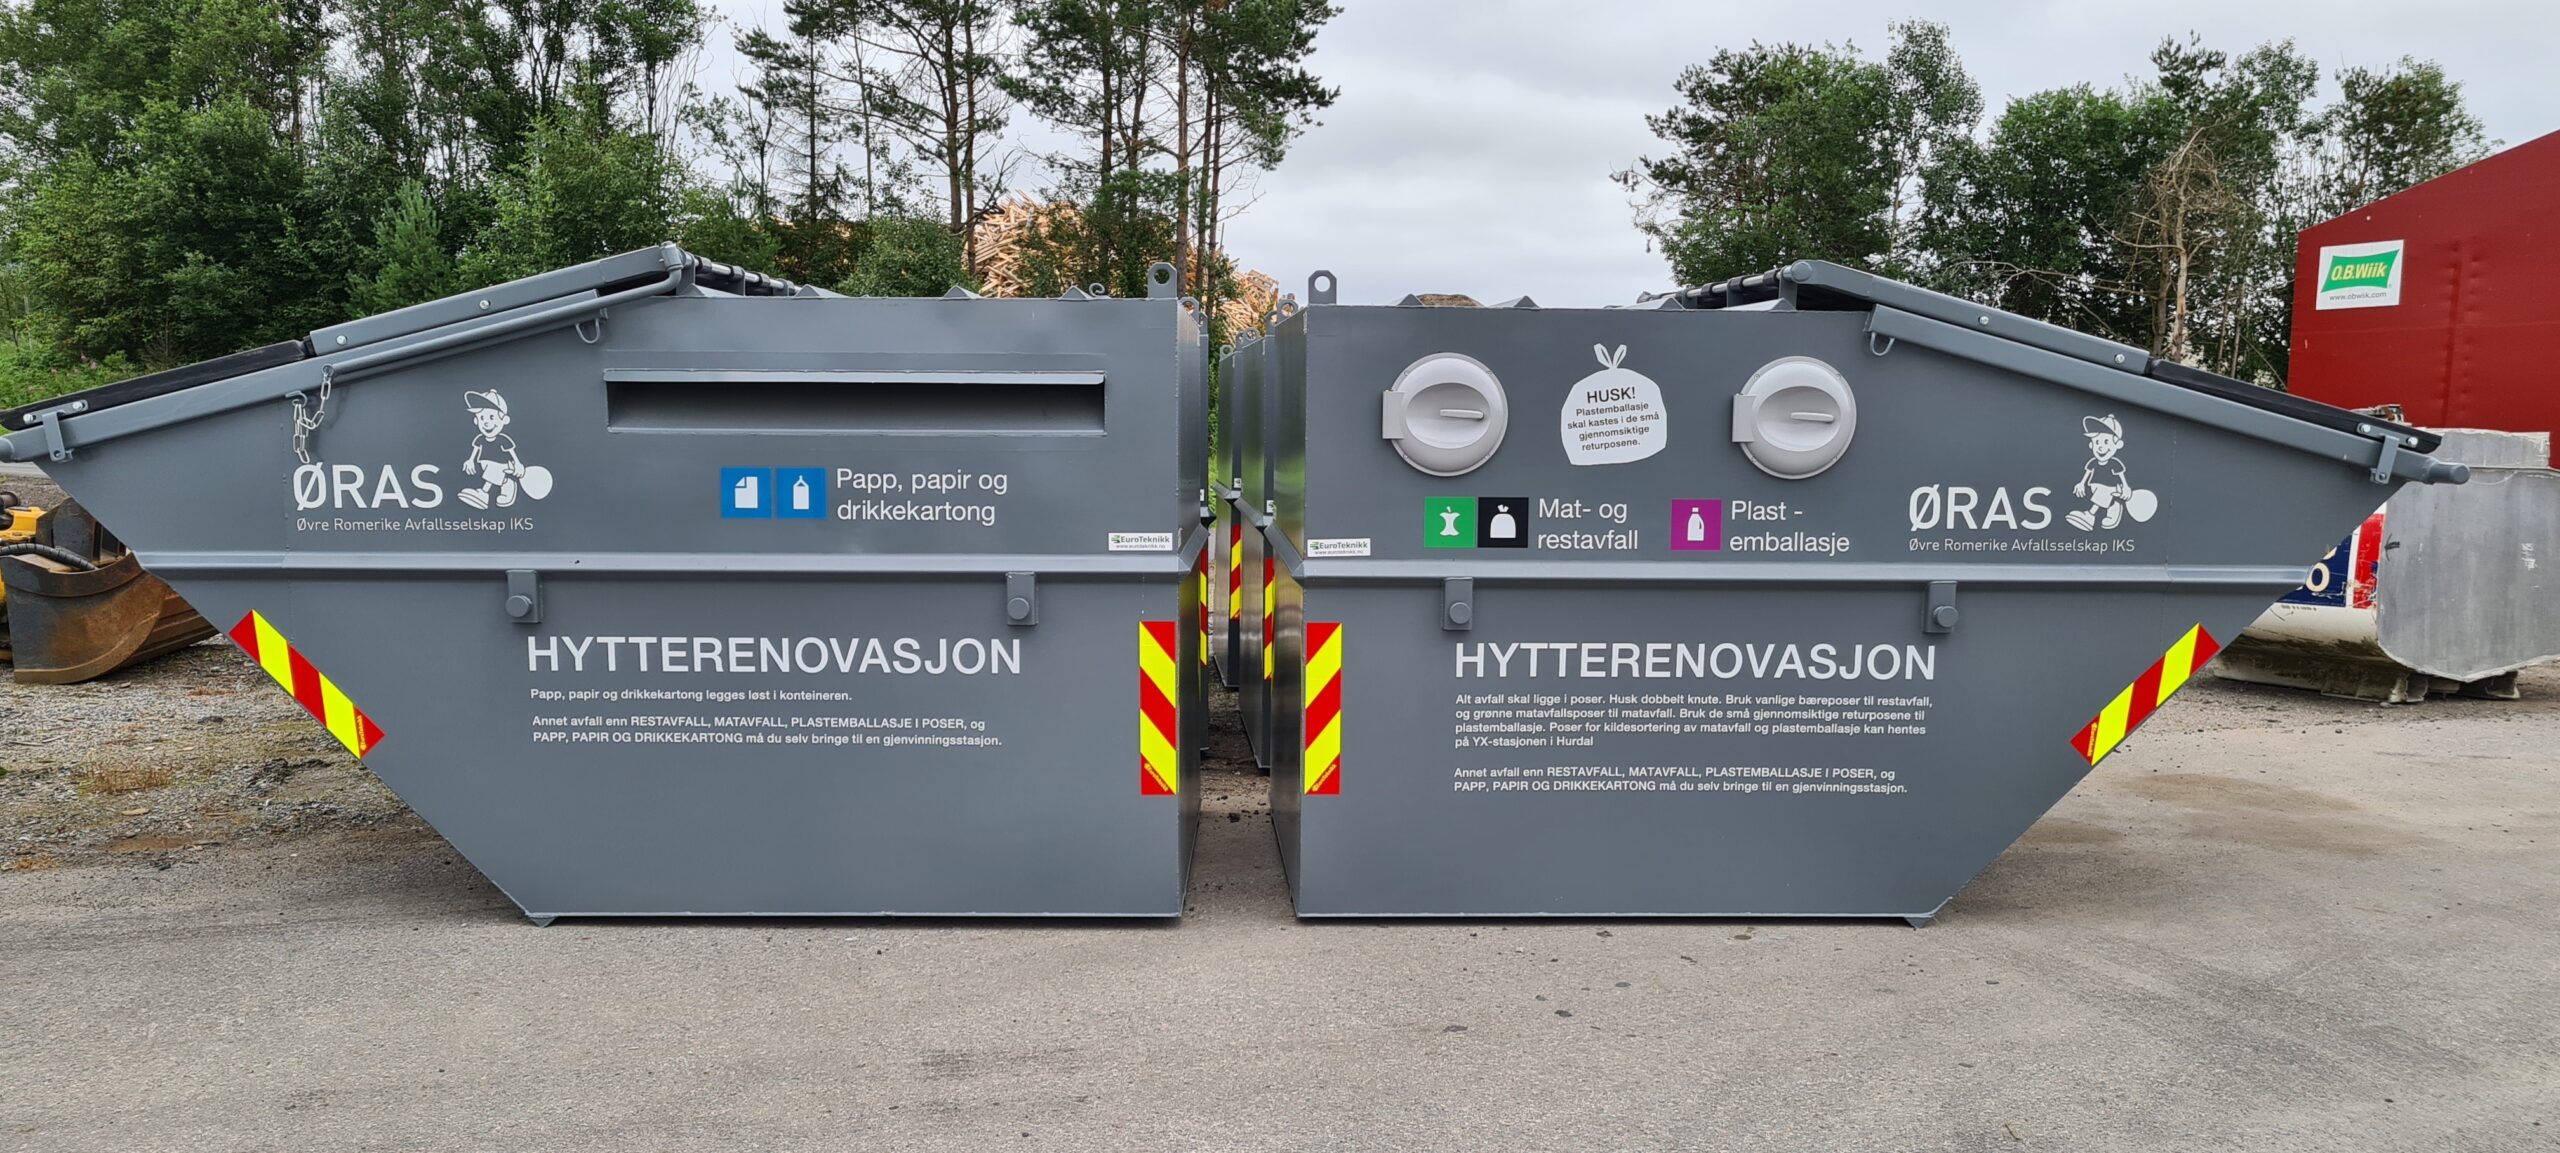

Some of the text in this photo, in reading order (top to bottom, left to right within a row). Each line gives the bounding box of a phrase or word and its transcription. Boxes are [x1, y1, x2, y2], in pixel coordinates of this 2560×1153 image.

[2331, 262, 2388, 281] O.B.Wiik
[1586, 386, 1636, 404] HUSK!
[1576, 402, 1649, 417] Plastemballasje
[1567, 419, 1586, 430] skal
[1588, 417, 1619, 428] kastes
[1625, 414, 1638, 424] de
[1639, 411, 1660, 422] små
[1578, 425, 1650, 442] gjennomsiktige
[1581, 439, 1641, 451] returposene.
[293, 461, 443, 511] ØRAS
[837, 468, 1008, 496] Papp, papir og
[837, 499, 995, 527] drikkekartong
[1539, 498, 1627, 524] Mat- og
[1731, 500, 1787, 521] Plast
[1909, 483, 2052, 532] ØRAS
[296, 517, 534, 534] Øvre Romerike Avfallsselskap IKS
[1120, 535, 1170, 543] EuroTeknikk
[1319, 541, 1368, 549] EuroTeknikk
[1538, 529, 1638, 550] restavfall
[1729, 531, 1850, 557] emballasje
[1909, 537, 2135, 555] Øvre Romerike Avfallsselskap IKS
[527, 636, 1021, 675] HYTTERENOVASJON
[1455, 642, 1936, 681] HYTTERENOVASJON
[530, 688, 566, 702] Papp,
[568, 688, 600, 702] papir
[602, 691, 618, 702] og
[620, 688, 703, 702] drikkekartong
[706, 689, 746, 702] legges
[748, 689, 771, 701] løst
[779, 690, 853, 701] konteineren.
[1455, 694, 1472, 705] Alt
[1474, 693, 1505, 705] avfall
[1507, 693, 1531, 704] skal
[1533, 693, 1561, 707] ligge
[1570, 695, 1606, 706] poser.
[1609, 693, 1638, 704] Husk
[1640, 694, 1685, 705] dobbelt
[1687, 694, 1722, 705] knute.
[1725, 694, 1752, 705] Bruk
[1755, 694, 1796, 707] vanlige
[1798, 695, 1861, 708] bæreposer
[1863, 695, 1874, 706] til
[1877, 696, 1933, 708] restavfall,
[1455, 707, 1925, 722] og grønne matavfallsposer til matavfall. Bruk de små gjennomsiktige returposene til
[532, 715, 568, 727] Annet
[570, 715, 603, 727] avfall
[605, 718, 628, 727] enn
[630, 715, 712, 729] RESTAVFALL,
[714, 716, 788, 729] MATAVFALL,
[791, 717, 913, 729] PLASTEMBALLASJE
[922, 718, 968, 731] POSER,
[970, 720, 986, 732] og
[1455, 721, 1926, 736] plastemballasje. Poser for kildesortering av matavfall og plastemballasje kan hentes
[533, 731, 1002, 748] PAPP, PAPIR OG DRIKKEKARTONG må du selv bringe til en gjenvinningsstasjon.
[1454, 735, 1470, 749] på
[1472, 736, 1547, 749] YX-stasjonen
[1556, 736, 1594, 746] Hurdal
[1453, 767, 1487, 778] Annet
[1489, 766, 1520, 778] avfall
[1522, 768, 1544, 777] enn
[1547, 766, 1625, 778] RESTAVFALL,
[1628, 766, 1702, 779] MATAVFALL,
[1705, 766, 1822, 778] PLASTEMBALLASJE
[1832, 768, 1877, 781] POSER,
[1880, 770, 1896, 782] og
[1454, 780, 1908, 795] PAPP, PAPIR OG DRIKKEKARTONG må du selv bringe til en gjenvinningsstasjon.
